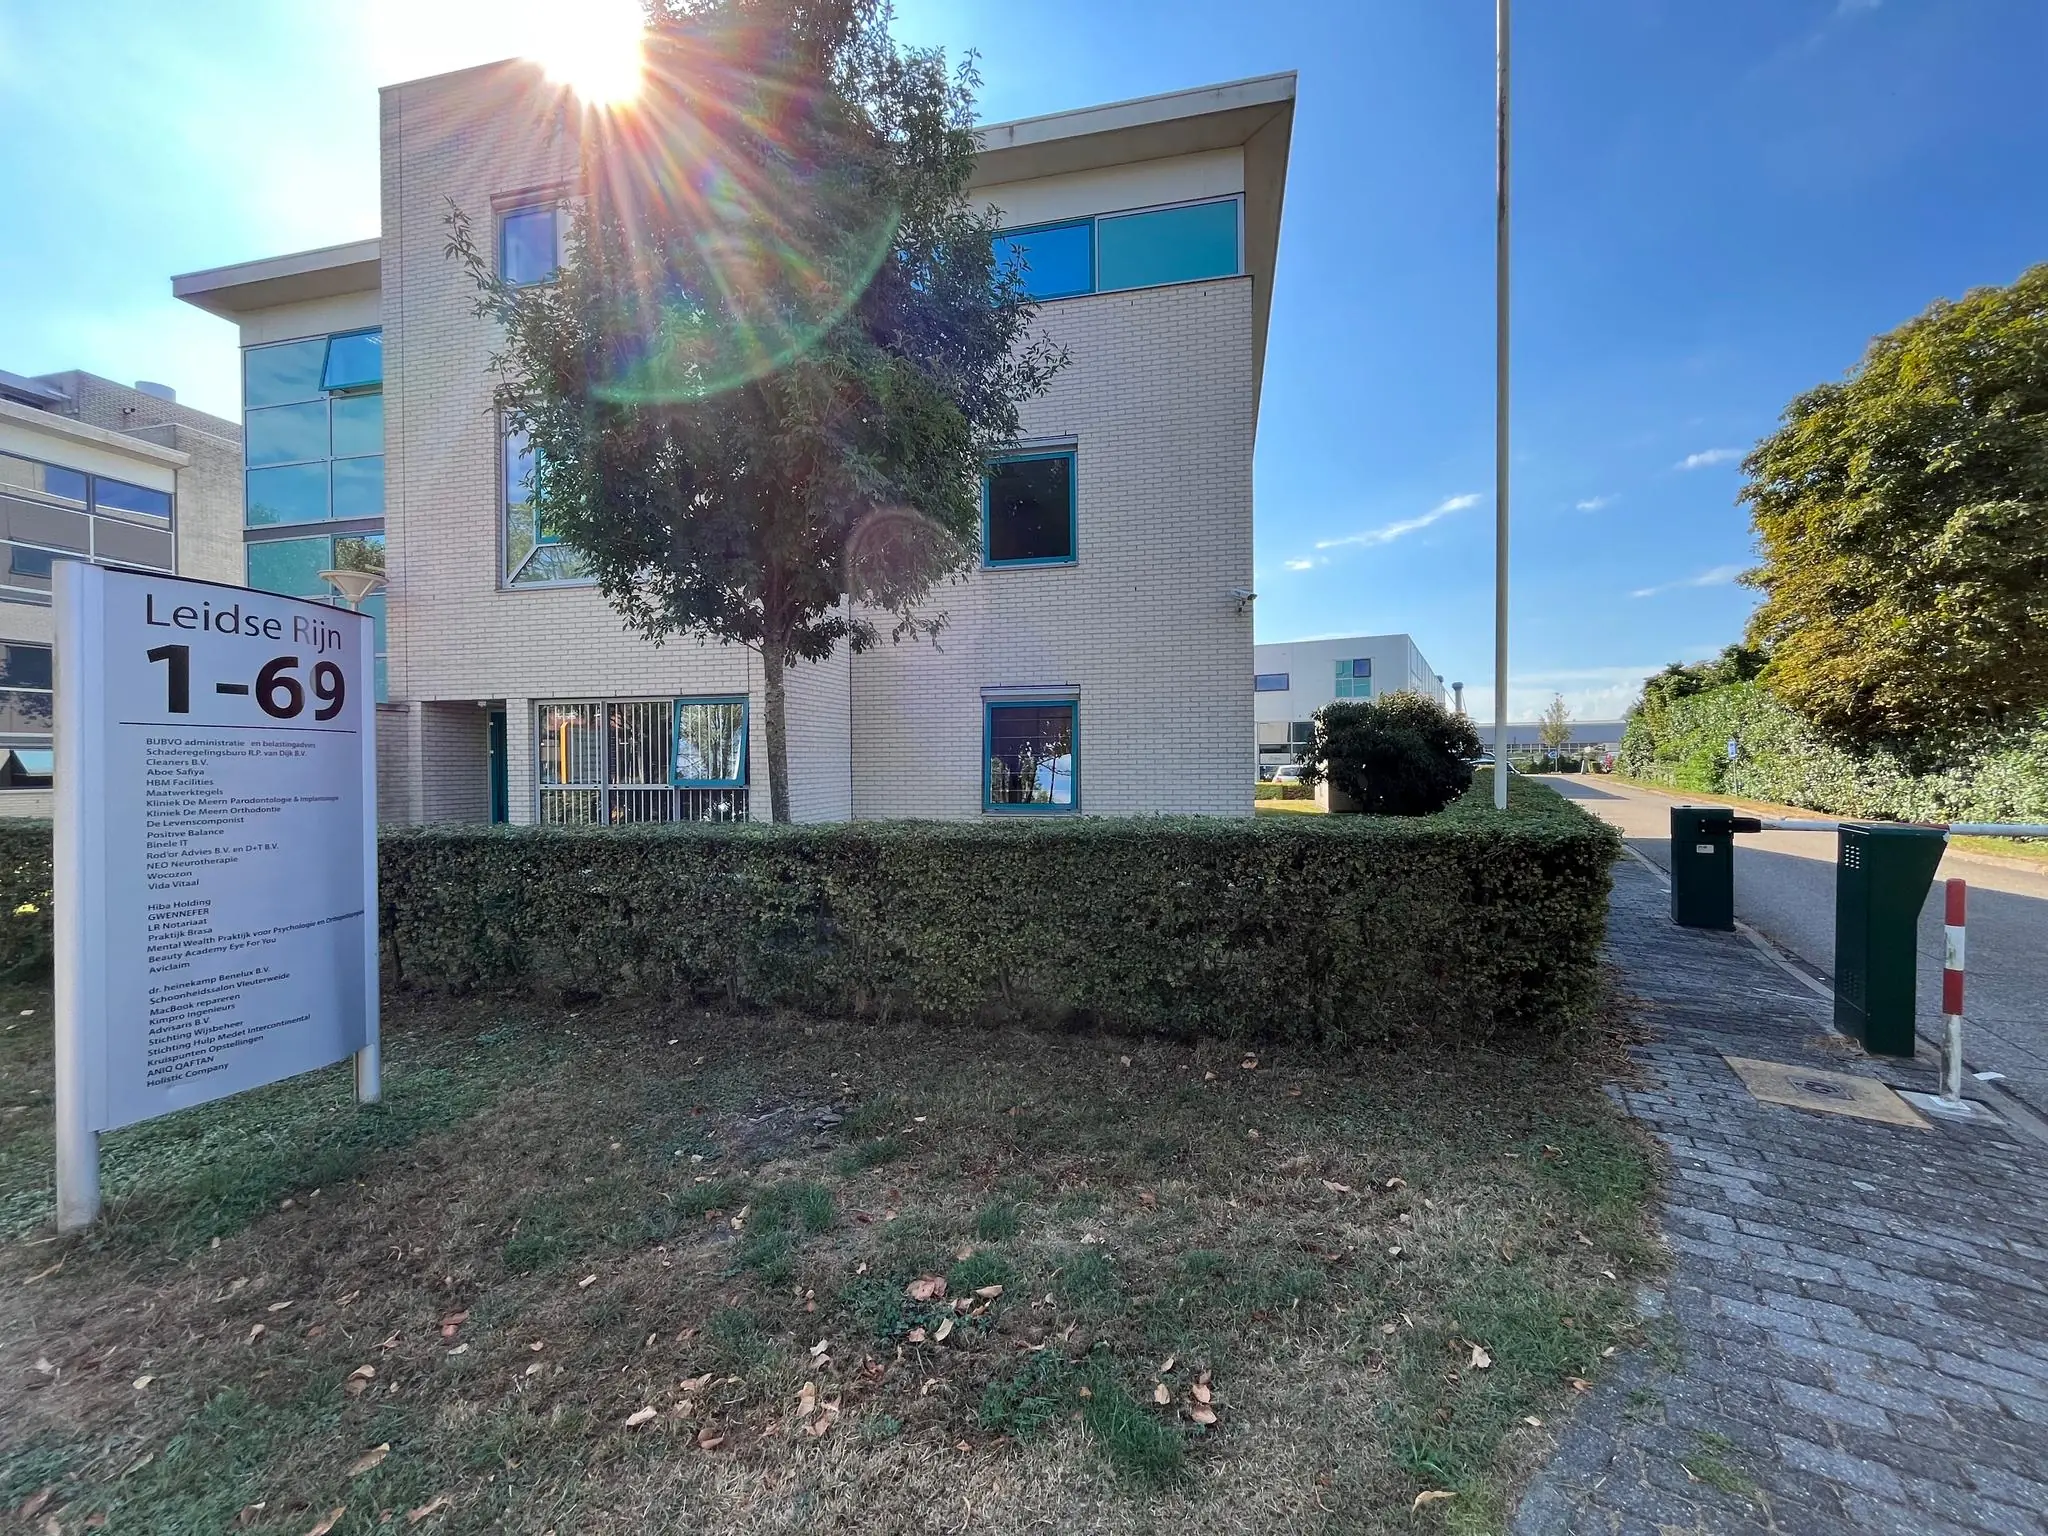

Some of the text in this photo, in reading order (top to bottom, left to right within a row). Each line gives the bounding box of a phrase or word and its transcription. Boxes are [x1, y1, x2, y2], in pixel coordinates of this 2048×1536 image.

[147, 594, 341, 654] Leidse Rijn
[185, 739, 245, 747] administratie
[146, 748, 246, 757] Schaderegelingsburo
[176, 768, 205, 776] Safiya
[146, 788, 223, 797] Maatwerktegels
[146, 799, 181, 807] Kliniek
[230, 806, 281, 814] Orthodontie
[146, 817, 245, 828] De Levenscomponist
[147, 829, 225, 839] Positive Balance
[179, 839, 188, 847] IT
[181, 849, 212, 857] Advies
[246, 844, 263, 852] D+T
[146, 856, 239, 870] NEO Neurotherapie
[147, 871, 192, 880] Wocozon
[148, 879, 200, 890] Vida Vitaal
[148, 899, 211, 911] Hiba Holding
[148, 907, 209, 921] GWENNEFER
[148, 918, 207, 932] LR Notariaat
[147, 942, 181, 953] Mental
[183, 937, 216, 947] Wealth
[218, 931, 251, 942] Praktijk
[253, 929, 271, 937] voor
[148, 927, 213, 942] Praktijk Brasa
[148, 937, 277, 964] Beauty Academy Eye For You
[149, 962, 190, 974] Aviclaim
[149, 987, 161, 995] dr.
[164, 977, 217, 992] heinekamp
[219, 969, 254, 981] Benelux
[149, 982, 235, 1005] Schoonheidssalon
[149, 994, 241, 1016] MacBook repareren
[149, 1004, 236, 1026] Kimpro Ingenieurs
[148, 1013, 311, 1057] Stichting Hulp Medet Intercontinental
[149, 1022, 193, 1036] Advisaris
[149, 1021, 244, 1046] Stichting Wijsbeheer
[147, 1034, 264, 1067] Kruispunten Opstellingen
[147, 1056, 215, 1077] ANIQ QAFTAN
[146, 1063, 229, 1088] Holistic Company
